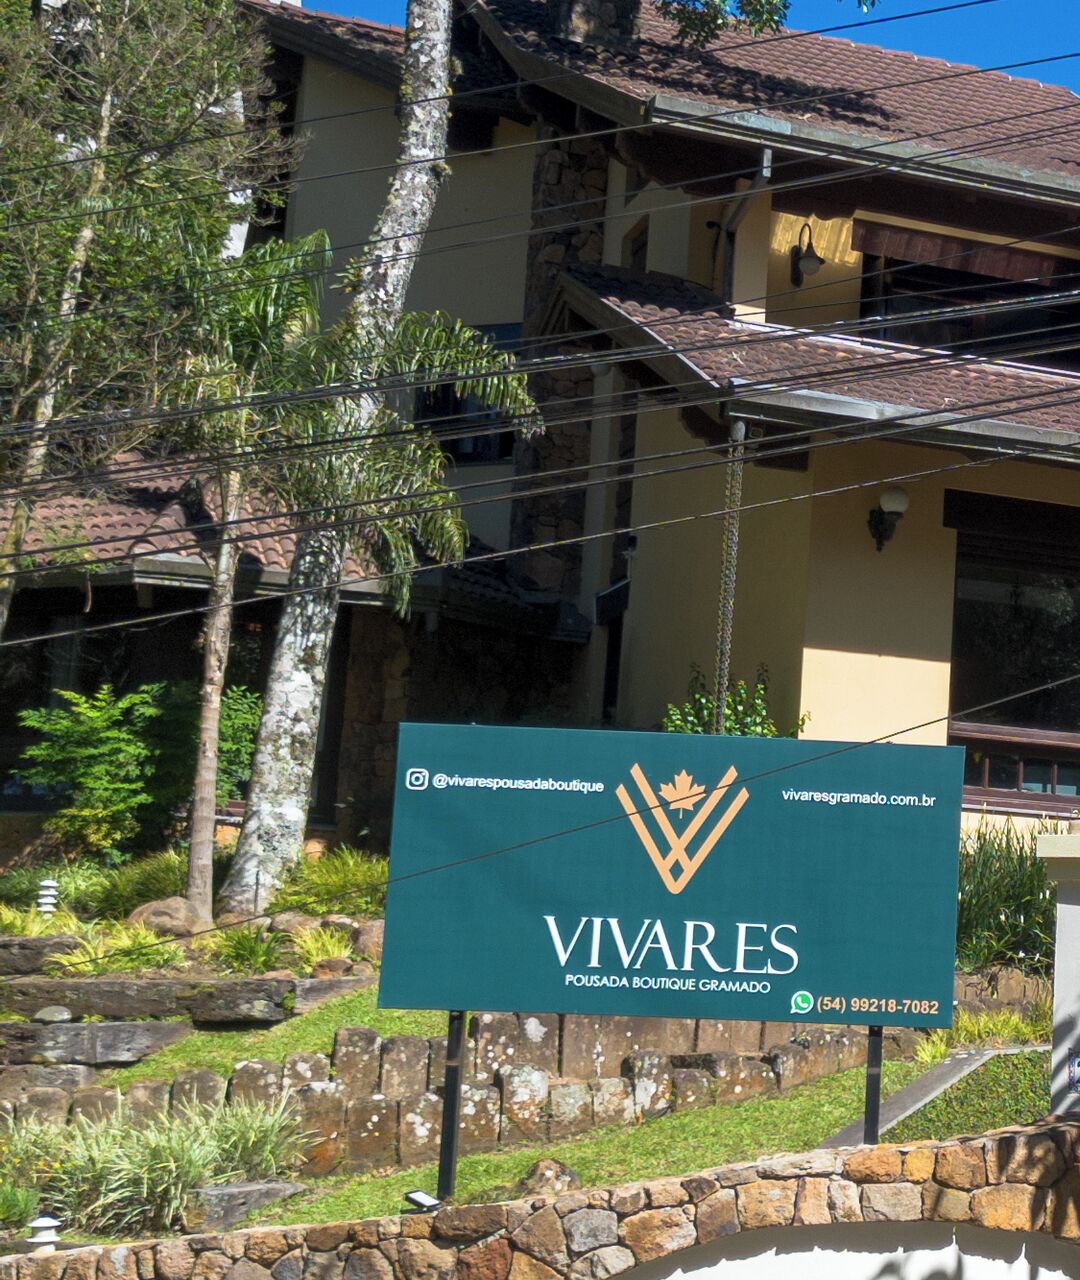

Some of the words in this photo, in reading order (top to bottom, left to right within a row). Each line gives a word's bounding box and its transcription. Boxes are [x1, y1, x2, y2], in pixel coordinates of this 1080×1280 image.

[432, 773, 604, 794] @vivarespousadaboutique
[781, 787, 937, 807] vivaresgramado.com.br
[543, 915, 800, 975] VIVARES
[565, 974, 629, 988] POUSADA
[632, 976, 696, 991] BOUTIQUE
[699, 978, 771, 994] GRAMADO
[816, 995, 847, 1014] (54)
[851, 996, 939, 1015] 99218-7082
